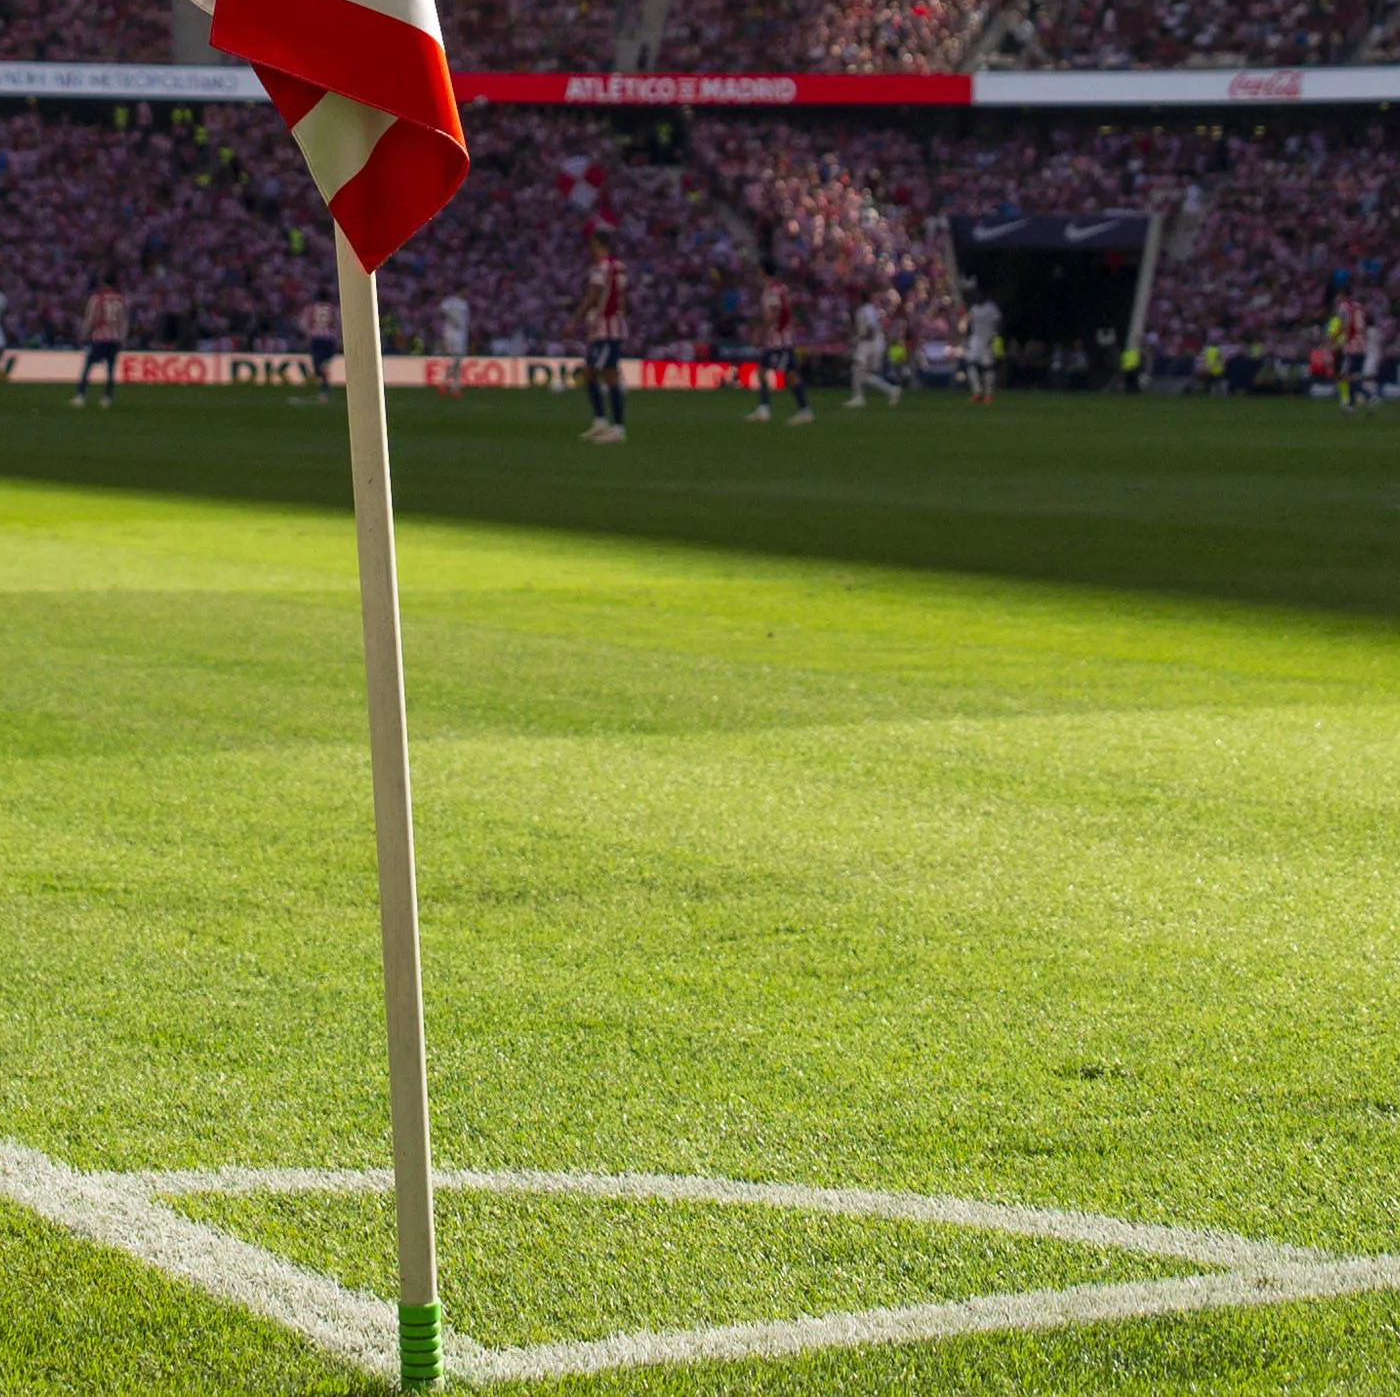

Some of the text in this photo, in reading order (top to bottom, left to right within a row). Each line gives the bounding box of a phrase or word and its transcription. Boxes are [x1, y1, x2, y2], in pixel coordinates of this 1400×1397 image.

[564, 72, 676, 103] ATLÉTICO
[700, 77, 797, 103] MADRID
[122, 355, 208, 384] ERGO
